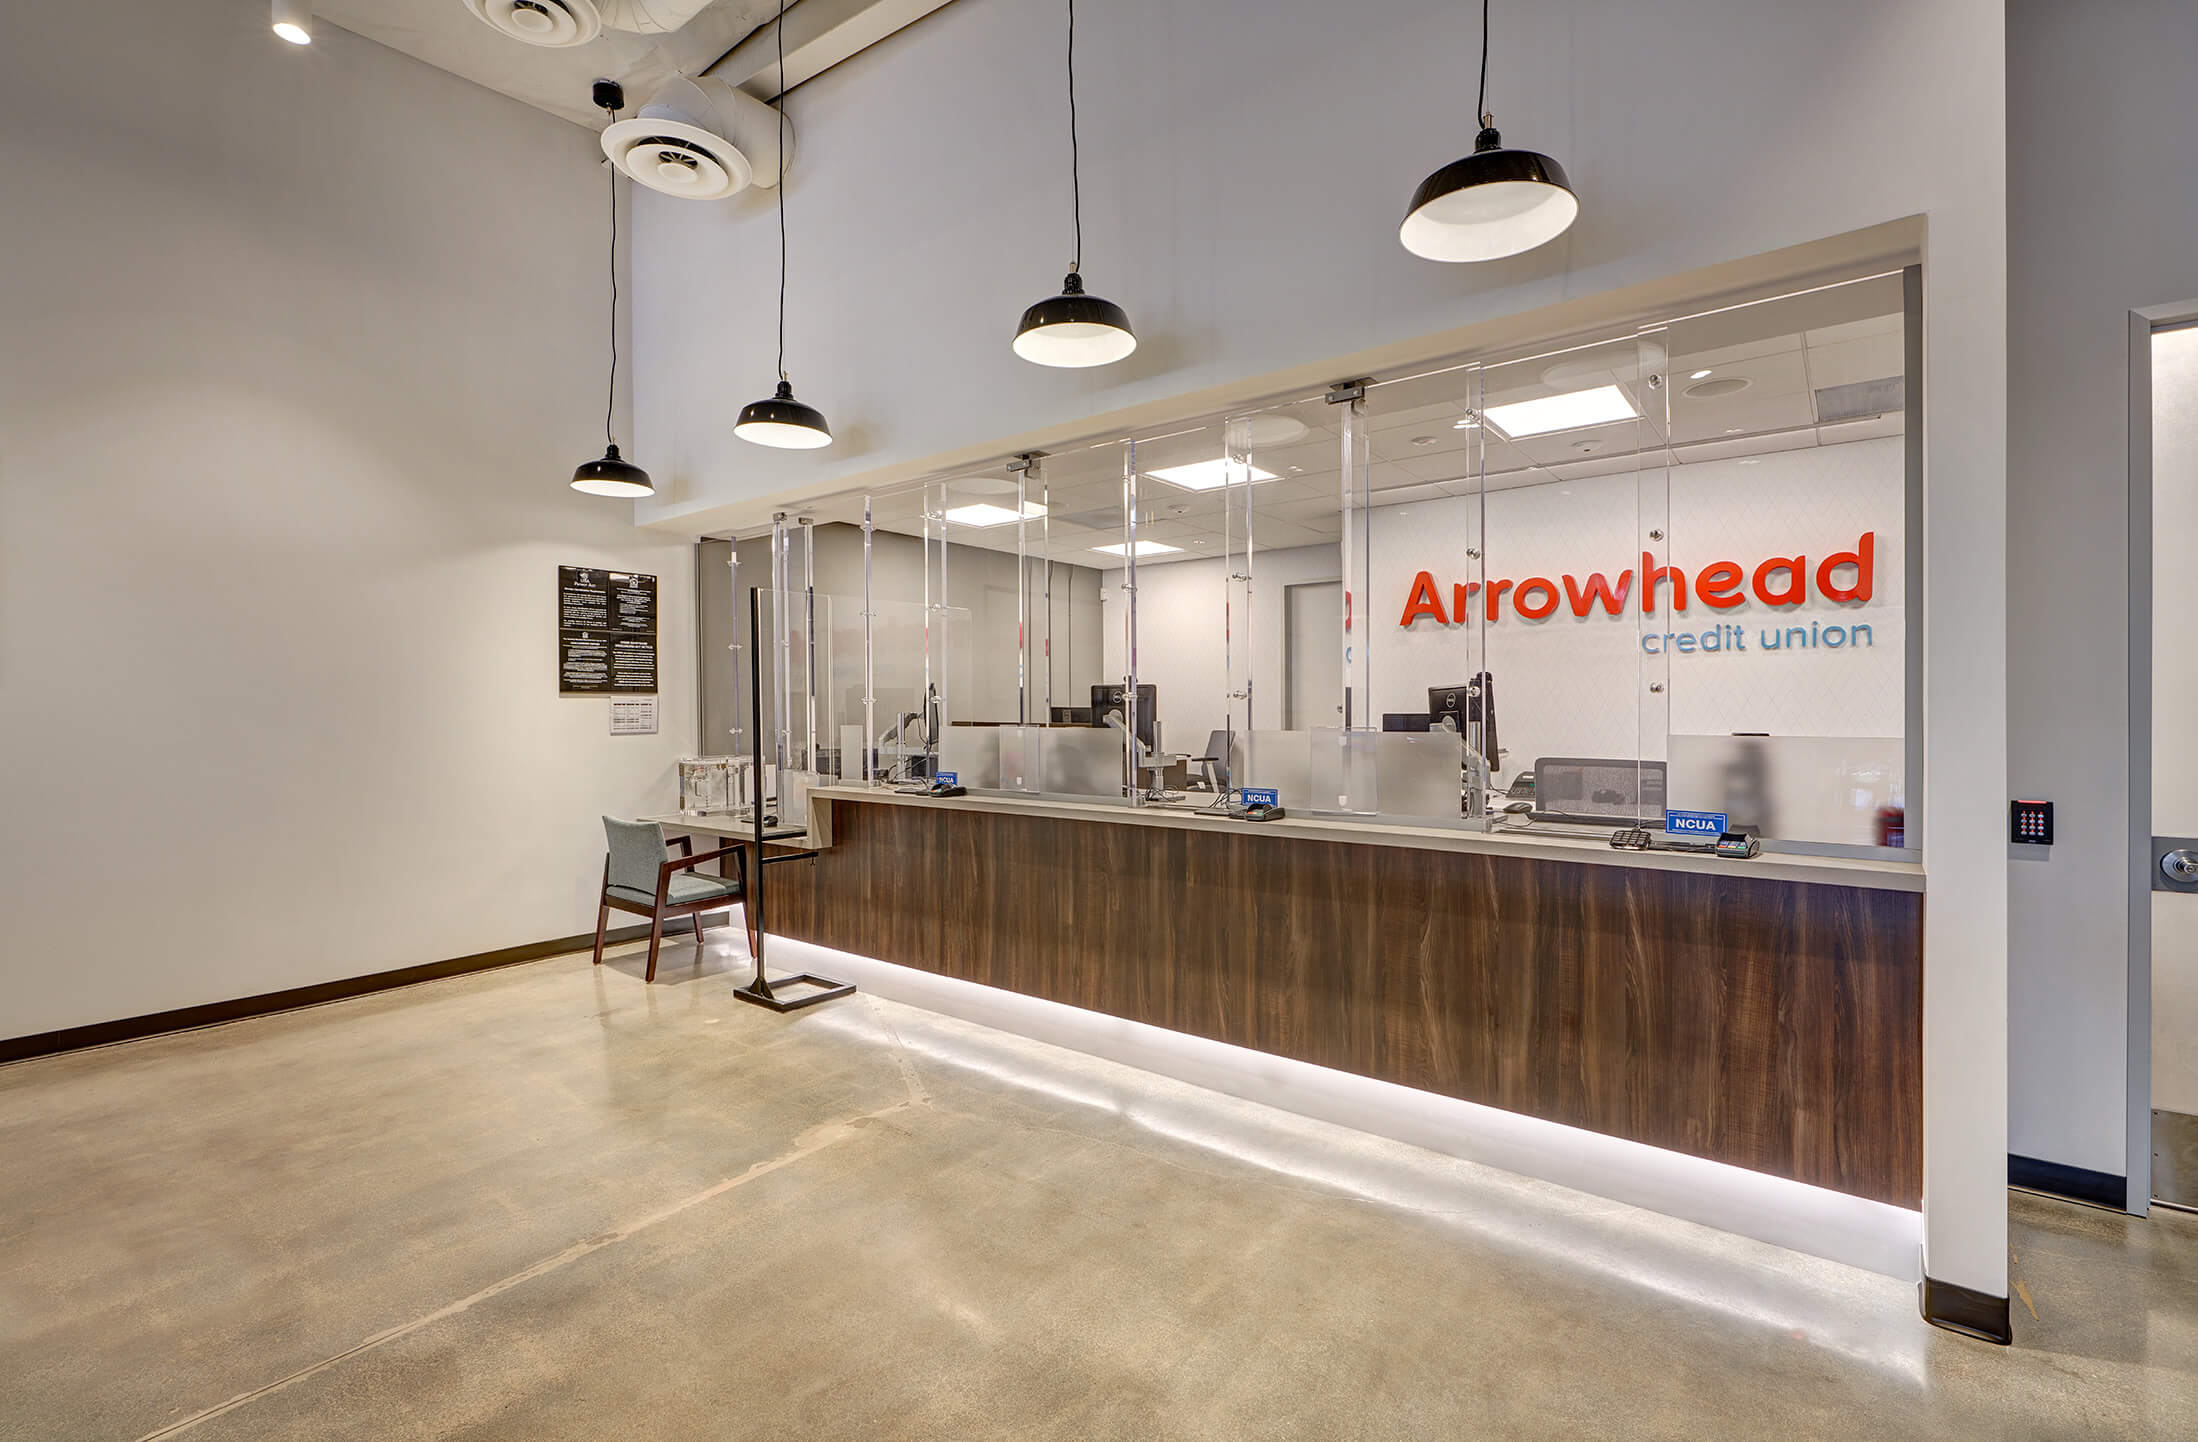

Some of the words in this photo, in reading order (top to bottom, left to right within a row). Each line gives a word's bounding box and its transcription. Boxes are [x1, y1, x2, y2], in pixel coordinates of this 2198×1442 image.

[1400, 531, 1874, 627] Arrowhead
[1641, 623, 1746, 653] credit
[1760, 620, 1873, 650] union
[1247, 793, 1272, 803] NCUA
[1675, 818, 1717, 832] NCUA
